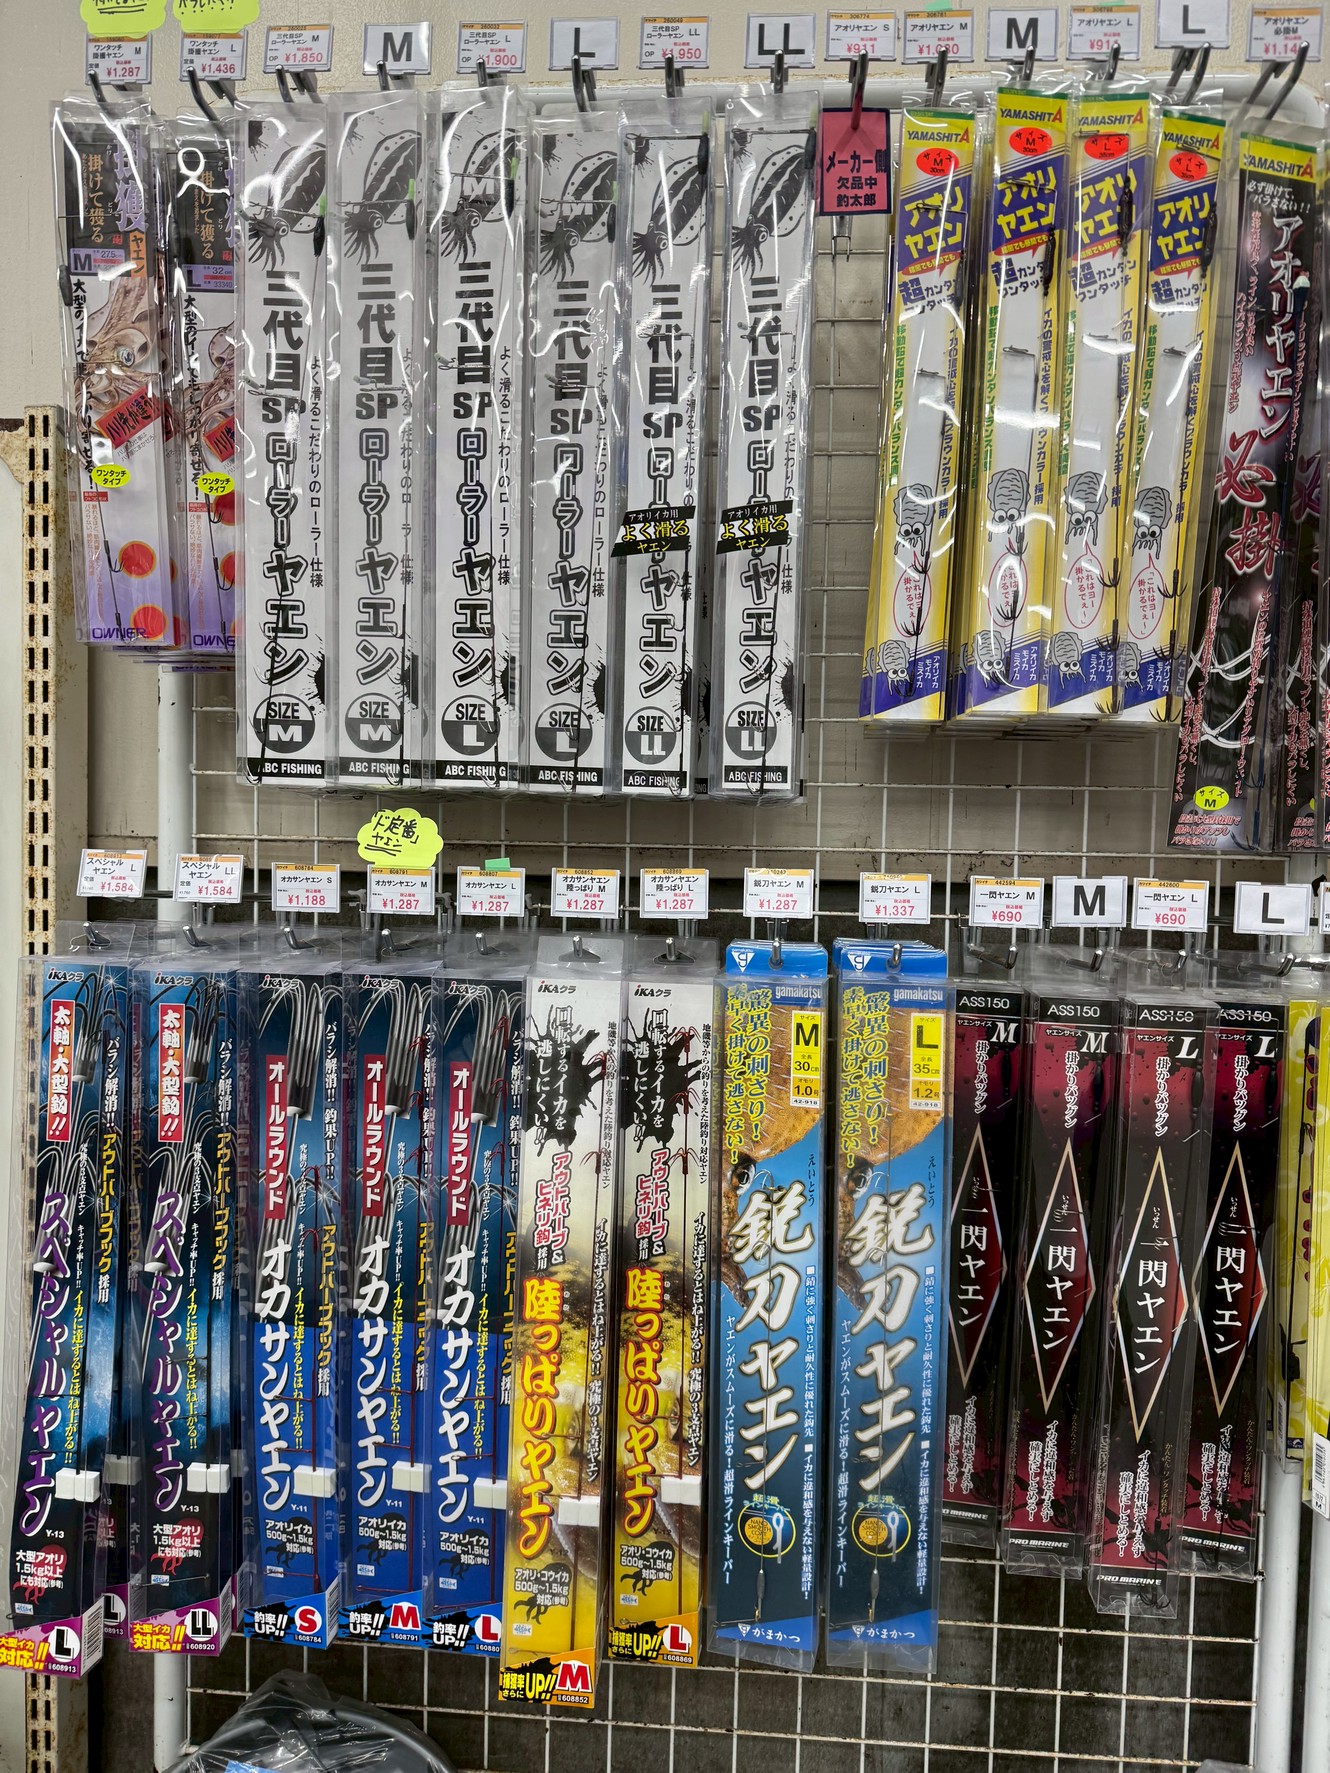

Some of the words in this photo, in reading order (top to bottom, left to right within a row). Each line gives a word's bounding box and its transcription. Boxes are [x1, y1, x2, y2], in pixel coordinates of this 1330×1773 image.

[1077, 18, 1122, 27] アオリヤエン
[1126, 18, 1133, 26] L
[1182, 4, 1206, 34] L
[1264, 17, 1309, 25] アオリヤエン
[688, 28, 700, 37] LL
[834, 24, 877, 32] アオリヤエン
[883, 23, 890, 32] S
[910, 23, 954, 32] アオリヤエン
[959, 23, 968, 31] M
[1006, 17, 1039, 49] M
[311, 34, 320, 42] M
[505, 35, 511, 43] L
[574, 27, 596, 58] L
[757, 23, 805, 56] LL
[134, 47, 142, 55] M
[230, 44, 236, 52] L
[382, 31, 413, 62] M
[1000, 106, 1062, 124] YAMASHITA
[1079, 106, 1143, 127] YAMASHITA
[907, 126, 970, 144] YAMASHITA
[825, 149, 888, 174] メーカー側
[837, 176, 878, 190] 欠品中
[88, 154, 105, 243] 掛けて獲る
[836, 193, 876, 208] 釣太郎
[96, 468, 127, 478] ワンタッチ
[102, 477, 122, 486] タイプ
[202, 478, 231, 487] ワンタッチ
[208, 485, 227, 494] タイプ
[628, 509, 679, 522] アオリイカ用
[622, 519, 689, 541] よく滑る
[92, 627, 146, 640] OWNER
[932, 655, 941, 689] アオリイカ
[268, 702, 300, 719] SIZE
[359, 701, 390, 719] SIZE
[455, 703, 486, 720] SIZE
[549, 710, 579, 727] SIZE
[257, 764, 280, 773] ABC
[349, 762, 368, 773] ABC
[370, 762, 410, 774] FISHING
[445, 764, 465, 775] ABC
[86, 858, 124, 866] スペシャル
[130, 864, 136, 872] L
[181, 862, 220, 870] スペシャル
[93, 866, 116, 875] ヤエン
[188, 871, 213, 879] ヤエン
[224, 867, 236, 876] LL
[280, 876, 323, 884] オカサンヤエン
[374, 879, 417, 888] オカサンヤエン
[562, 876, 611, 884] オカサンヤエン
[650, 875, 699, 884] オカサンヤエン
[753, 879, 792, 888] 鋭刀ヤエン
[796, 880, 805, 889] M
[465, 882, 507, 890] オカサンヤエン
[566, 884, 594, 892] 陸っぱり
[598, 885, 606, 893] M
[655, 883, 684, 892] 陸っぱり
[688, 884, 694, 892] L
[870, 885, 910, 894] 鋭刀ヤエン
[914, 885, 920, 894] L
[980, 891, 1020, 900] 一閃ヤエン
[1026, 891, 1036, 900] M
[1073, 885, 1106, 916] M
[1144, 893, 1185, 903] 一閃ヤエン
[1191, 893, 1198, 903] L
[1261, 892, 1285, 925] L
[991, 911, 1023, 923] ¥690
[1154, 913, 1186, 926] ¥690
[775, 986, 822, 1001] gamakatsu
[893, 988, 944, 1002] gamakatsu
[958, 996, 1010, 1009] ASS150
[1047, 1004, 1100, 1018] ASS150
[1139, 1009, 1195, 1023] ASS150
[957, 1019, 992, 1027] ヤエンサイズ
[1046, 1028, 1082, 1037] ヤエンサイズ
[1136, 1034, 1175, 1043] ヤエンサイズ
[552, 1005, 573, 1130] 回転するイカを
[650, 1008, 669, 1128] 回転するイカを
[746, 988, 773, 1142] 驚異の刺さり!
[862, 991, 890, 1145] 驚異の刺さり!
[913, 1063, 940, 1075] 35cm
[974, 1040, 990, 1114] 掛かりバツグン
[794, 1085, 819, 1097] 1.0号
[913, 1088, 940, 1099] 1.2号
[1064, 1050, 1079, 1129] 掛かりバツグン
[793, 1098, 818, 1106] 42-918
[1154, 1056, 1172, 1137] 掛かりバツグン
[268, 1061, 285, 1211] オールラウンド
[366, 1061, 383, 1208] オールラウンド
[451, 1068, 470, 1217] オールラウンド
[957, 1207, 989, 1327] 一閃ヤエン
[1042, 1226, 1078, 1350] 一閃ヤエン
[1134, 1240, 1169, 1374] 一閃ヤエン
[152, 1192, 187, 1513] スペシャルヤエン
[19, 1191, 72, 1537] スペシャルヤエン
[624, 1267, 663, 1537] 陸っぱりヤエン
[518, 1278, 563, 1559] 陸っぱりヤエン
[180, 1505, 200, 1513] Y-13
[291, 1503, 308, 1512] Y-11
[385, 1499, 403, 1508] Y-11
[467, 1516, 485, 1524] Y-11
[949, 1509, 988, 1520] MARINE
[152, 1523, 201, 1537] 大型アオリ
[801, 1453, 814, 1600] イカに違和感を与えない軽量設計!
[45, 1529, 65, 1539] Y-13
[153, 1536, 201, 1549] 1.5kg以上
[1009, 1538, 1029, 1546] PRO
[1029, 1538, 1070, 1548] MARINE
[15, 1550, 64, 1565] 大型アオリ
[514, 1568, 570, 1582] アオリ・コウイカ
[1096, 1574, 1119, 1582] PRO
[1120, 1576, 1162, 1585] MARINE
[297, 1608, 318, 1631] S
[132, 1623, 171, 1635] 大型イカ
[866, 1627, 915, 1640] がまかつ
[298, 1635, 322, 1644] 608784
[394, 1633, 419, 1642] 608791
[752, 1628, 800, 1643] がまかつ
[190, 1642, 215, 1651] 608920
[611, 1646, 633, 1655] さらに
[667, 1655, 693, 1663] 608869
[52, 1663, 77, 1673] 608913
[502, 1690, 524, 1699] さらに
[562, 1695, 588, 1704] 608852
